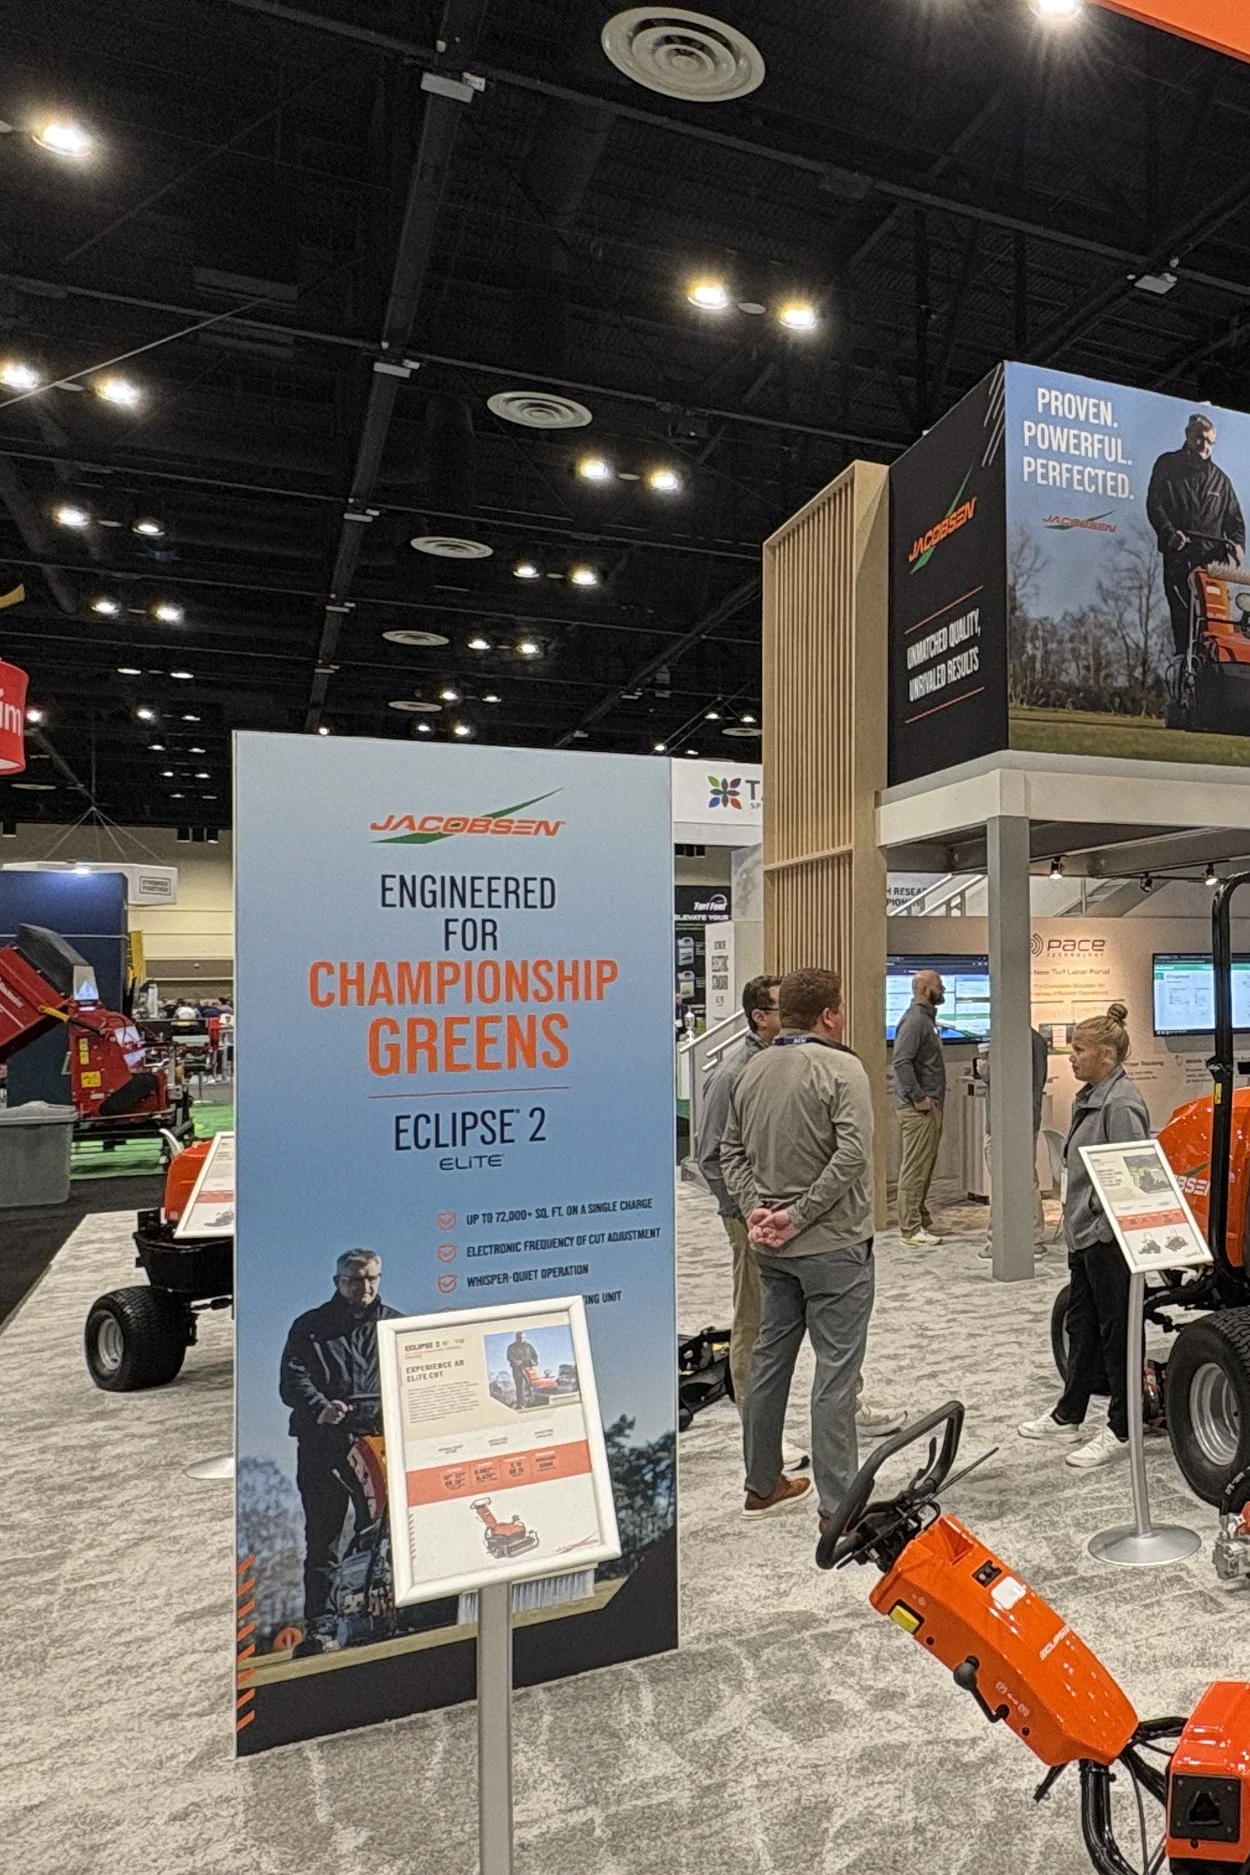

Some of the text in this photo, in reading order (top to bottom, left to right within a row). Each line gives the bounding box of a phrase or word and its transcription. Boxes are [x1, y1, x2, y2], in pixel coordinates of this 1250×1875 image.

[1037, 386, 1118, 427] PROVEN.
[1022, 420, 1133, 466] POWERFUL.
[1022, 456, 1135, 500] PERFECTED.
[908, 496, 977, 562] JACOBSEN
[1042, 515, 1118, 533] JACOBSEN
[907, 608, 981, 670] UNMATCHED QUALITY,
[947, 646, 979, 684] RESULTS
[369, 814, 560, 837] JACOBSEN
[380, 874, 556, 909] ENGINEERED
[443, 918, 498, 951] FOR
[309, 959, 618, 1008] CHAMPIONSHIP
[368, 1014, 569, 1076] GREENS
[528, 1106, 547, 1143] 2
[467, 1212, 479, 1225] UP
[482, 1211, 493, 1224] TO
[495, 1209, 532, 1223] 72,000+
[566, 1204, 579, 1216] ON
[580, 1203, 588, 1214] A
[588, 1201, 617, 1214] SINGLE
[619, 1198, 653, 1210] CHARGE
[467, 1227, 661, 1257] ELECTRONIC FREQUENCY OF CUT ADJUSTMENT
[467, 1264, 589, 1287] WHISPER-QUIET OPERATION
[602, 1290, 622, 1303] UNIT
[406, 1361, 452, 1374] EXPERIENCE
[428, 1371, 443, 1379] CUT
